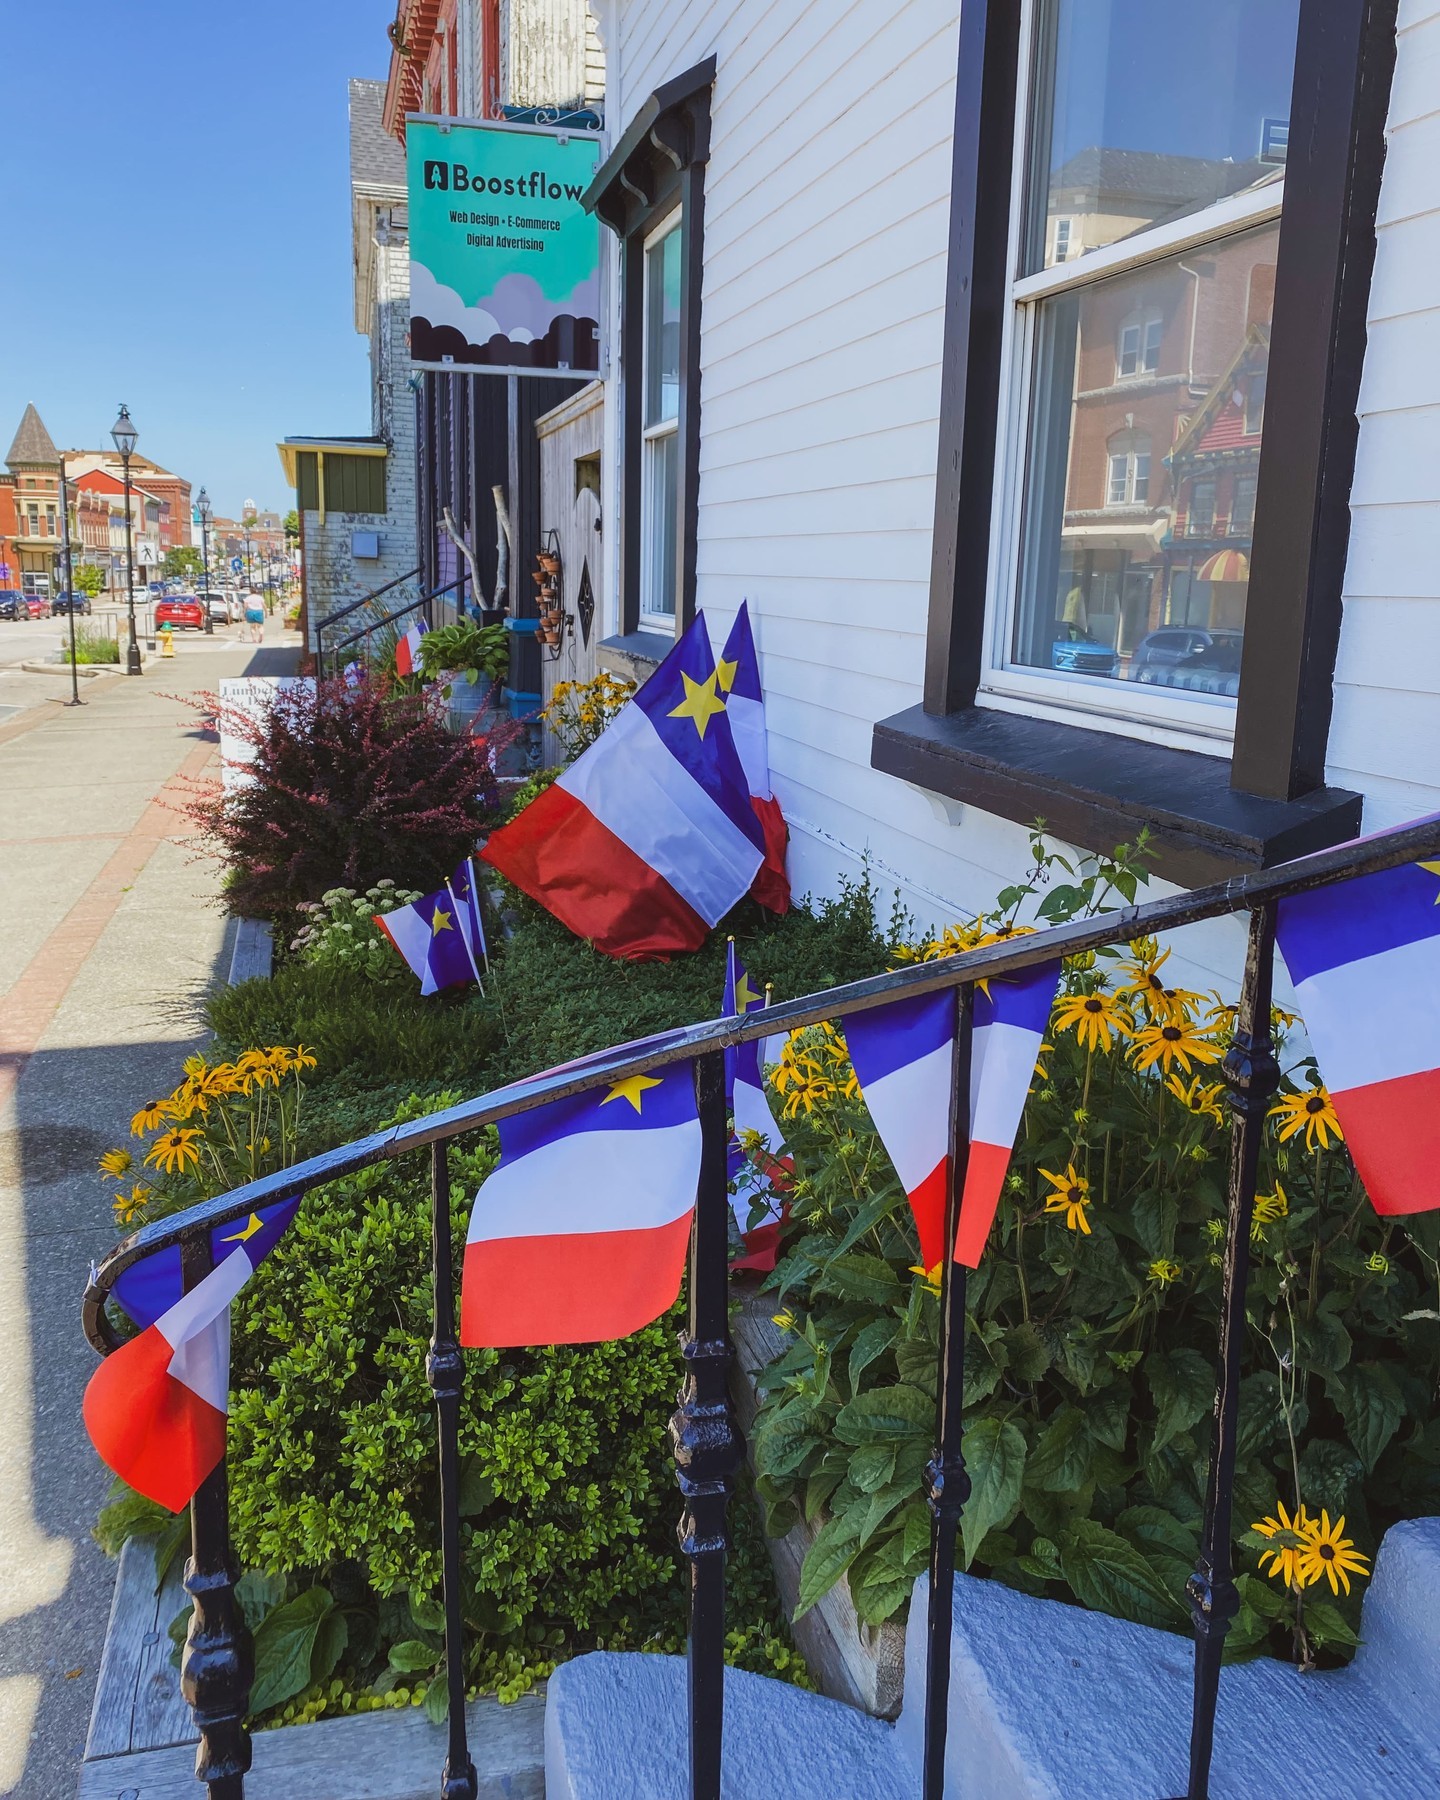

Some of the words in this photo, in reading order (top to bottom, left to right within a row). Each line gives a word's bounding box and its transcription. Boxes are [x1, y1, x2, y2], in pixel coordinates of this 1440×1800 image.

[452, 163, 584, 201] Boostflow
[449, 210, 468, 224] Web
[470, 212, 499, 226] Design
[508, 215, 561, 231] E-Commerce
[467, 233, 494, 247] Digital
[496, 235, 544, 252] Advertising
